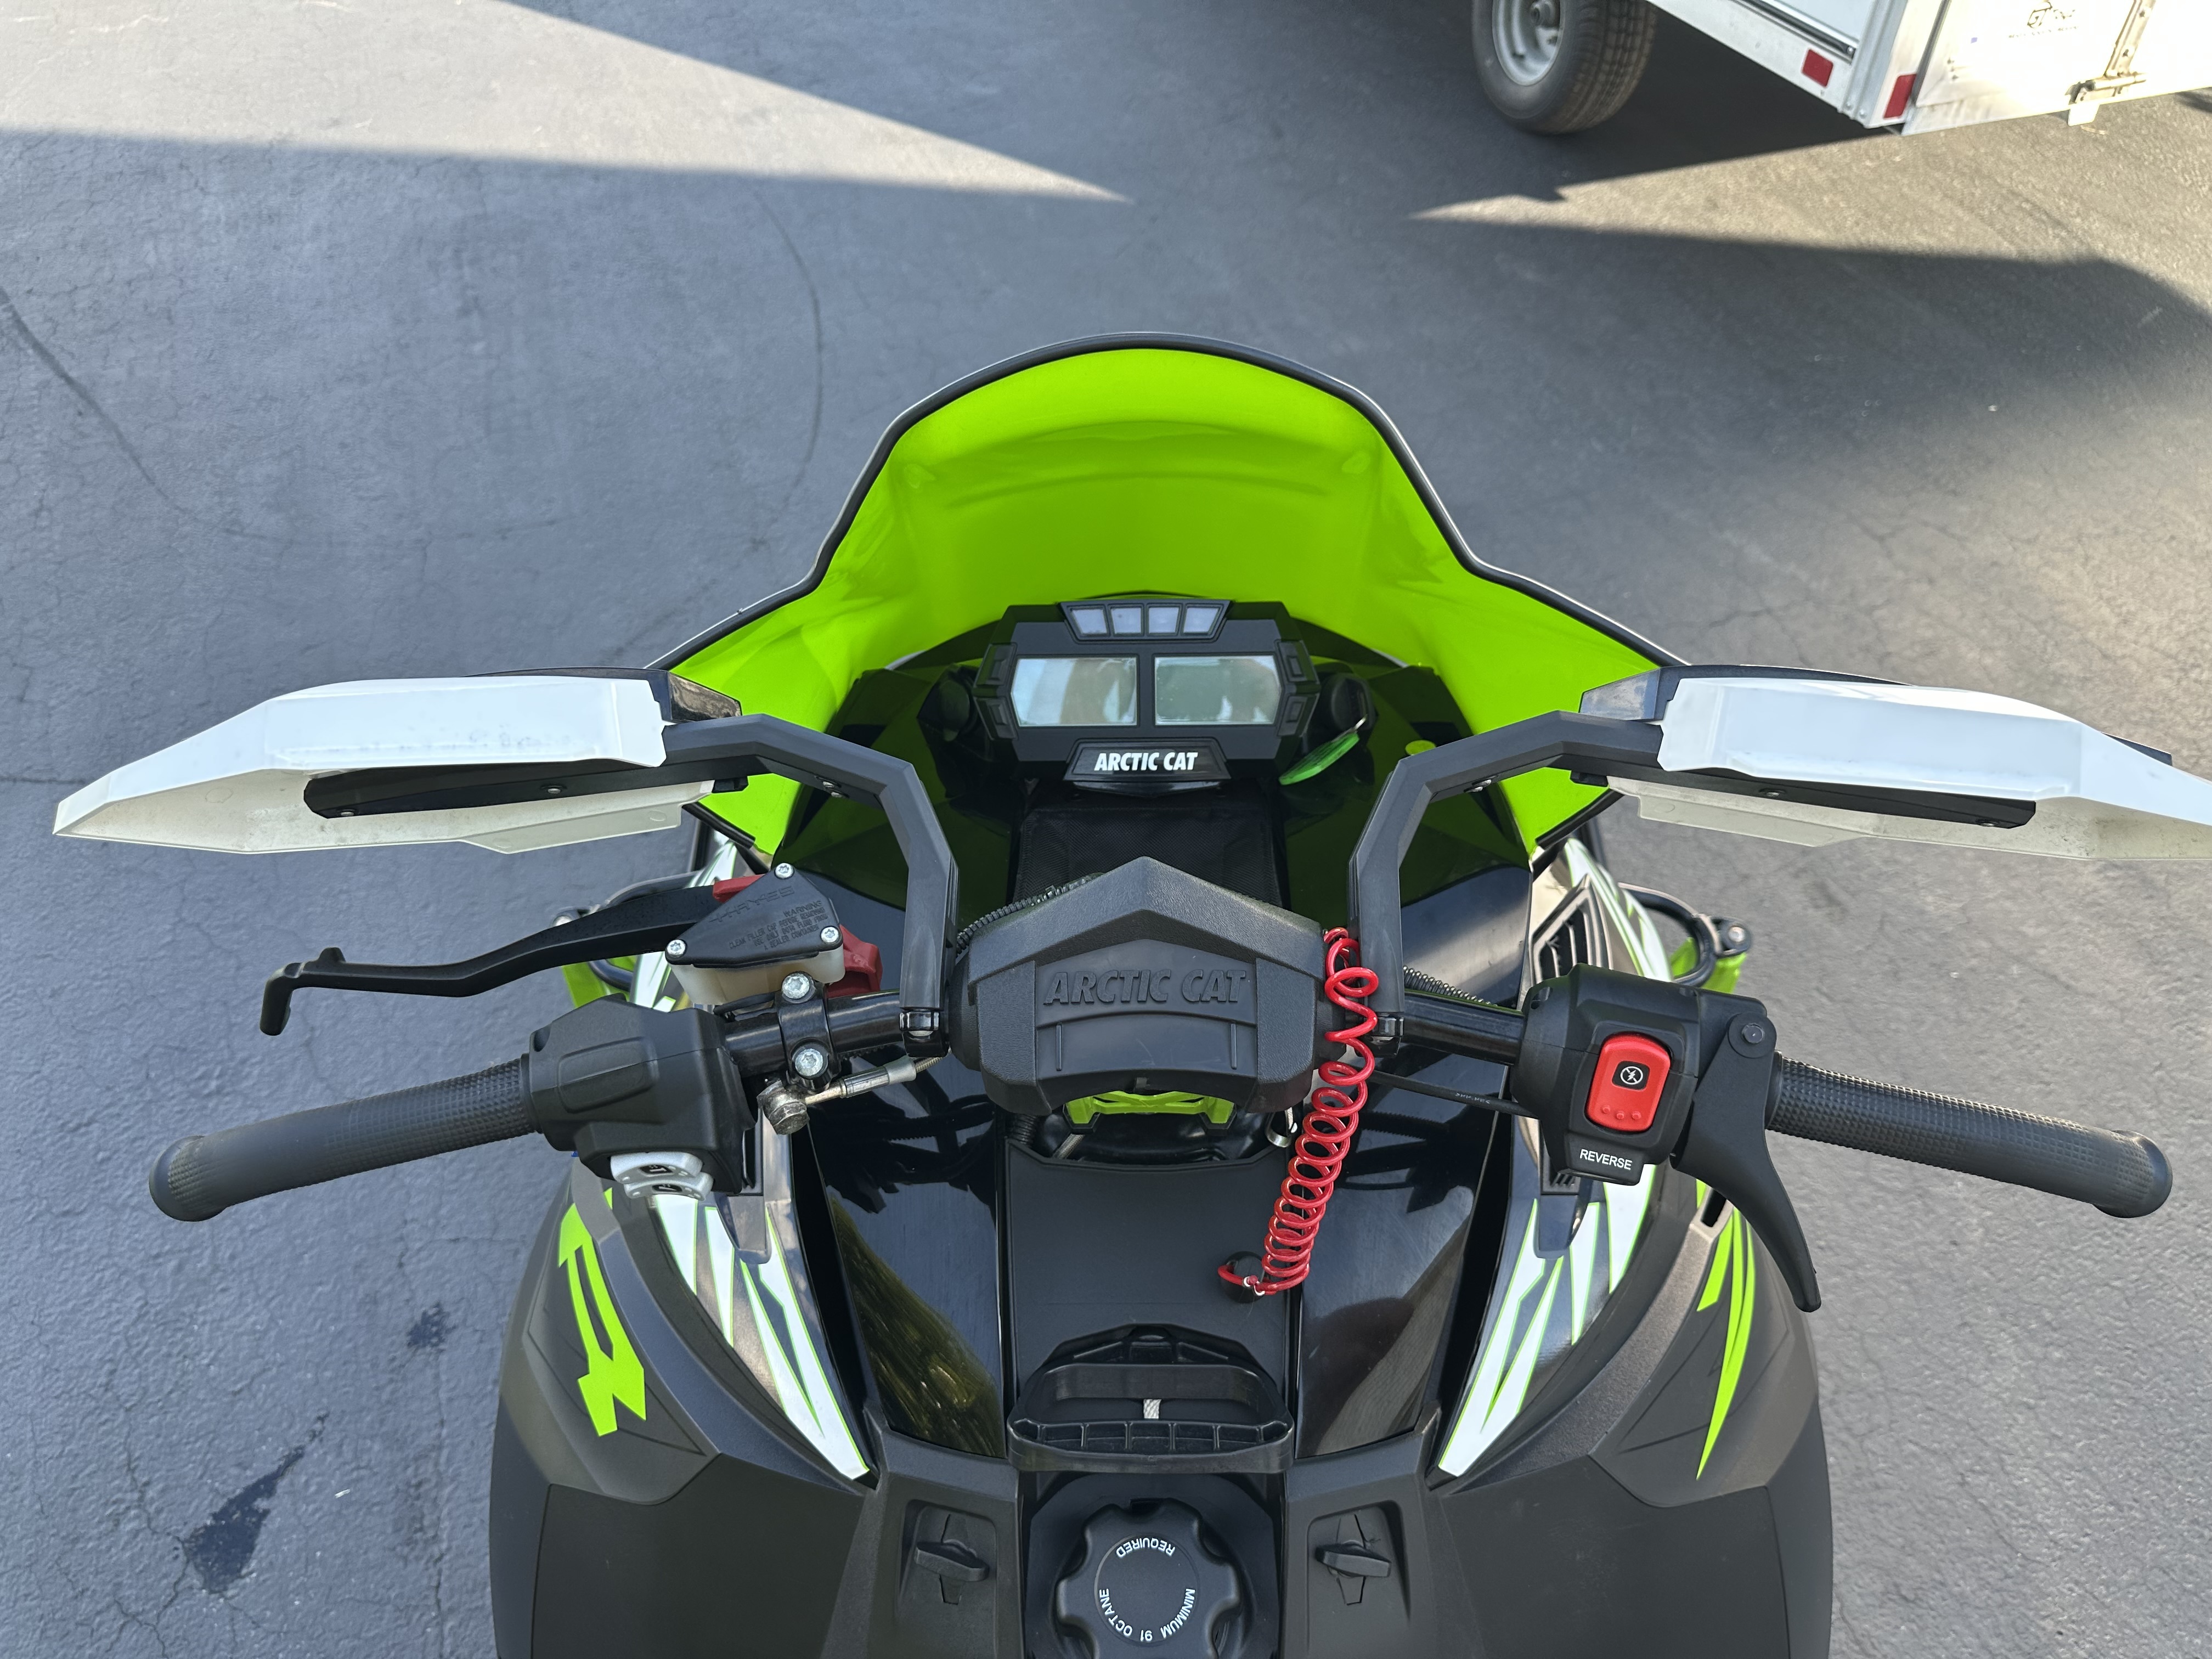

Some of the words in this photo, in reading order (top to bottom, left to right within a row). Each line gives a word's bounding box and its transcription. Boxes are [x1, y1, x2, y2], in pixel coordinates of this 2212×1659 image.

[1094, 752, 1160, 771] ARCTIC
[1163, 752, 1198, 771] CAT
[782, 900, 822, 917] WARNING
[747, 928, 765, 940] FILLER
[767, 923, 777, 932] CAP
[1043, 969, 1171, 1005] ARCTIC
[1181, 969, 1246, 1003] CAT
[1579, 1148, 1633, 1170] REVERSE
[1115, 1537, 1176, 1558] REQUIRED
[1099, 1588, 1133, 1637] OCTANE
[1160, 1588, 1196, 1639] MINIMUM
[1140, 1629, 1153, 1642] 91
